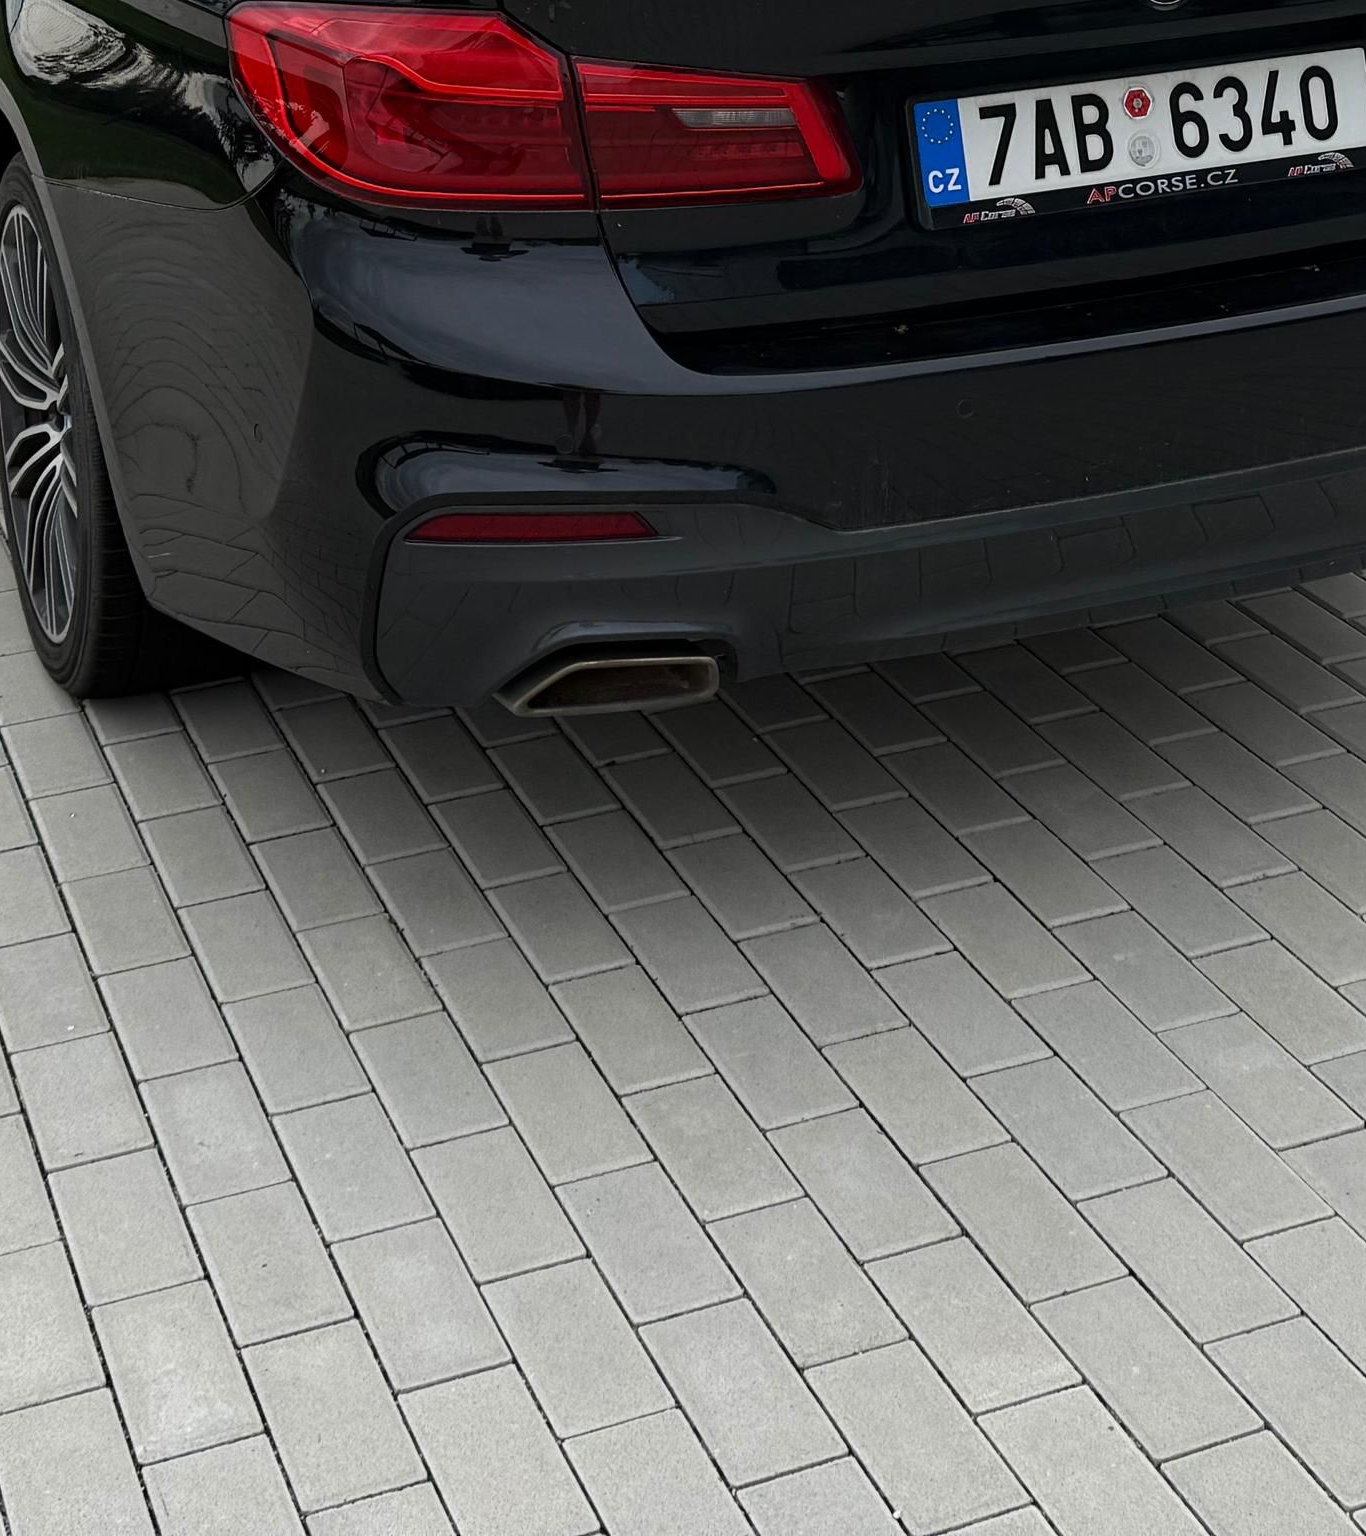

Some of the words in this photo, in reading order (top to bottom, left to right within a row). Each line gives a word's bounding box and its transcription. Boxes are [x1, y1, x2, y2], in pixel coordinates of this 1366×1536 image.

[978, 92, 1115, 186] 7AB
[1168, 64, 1338, 159] 6340
[928, 167, 962, 194] CZ
[1086, 168, 1239, 205] APCORSE.CZ
